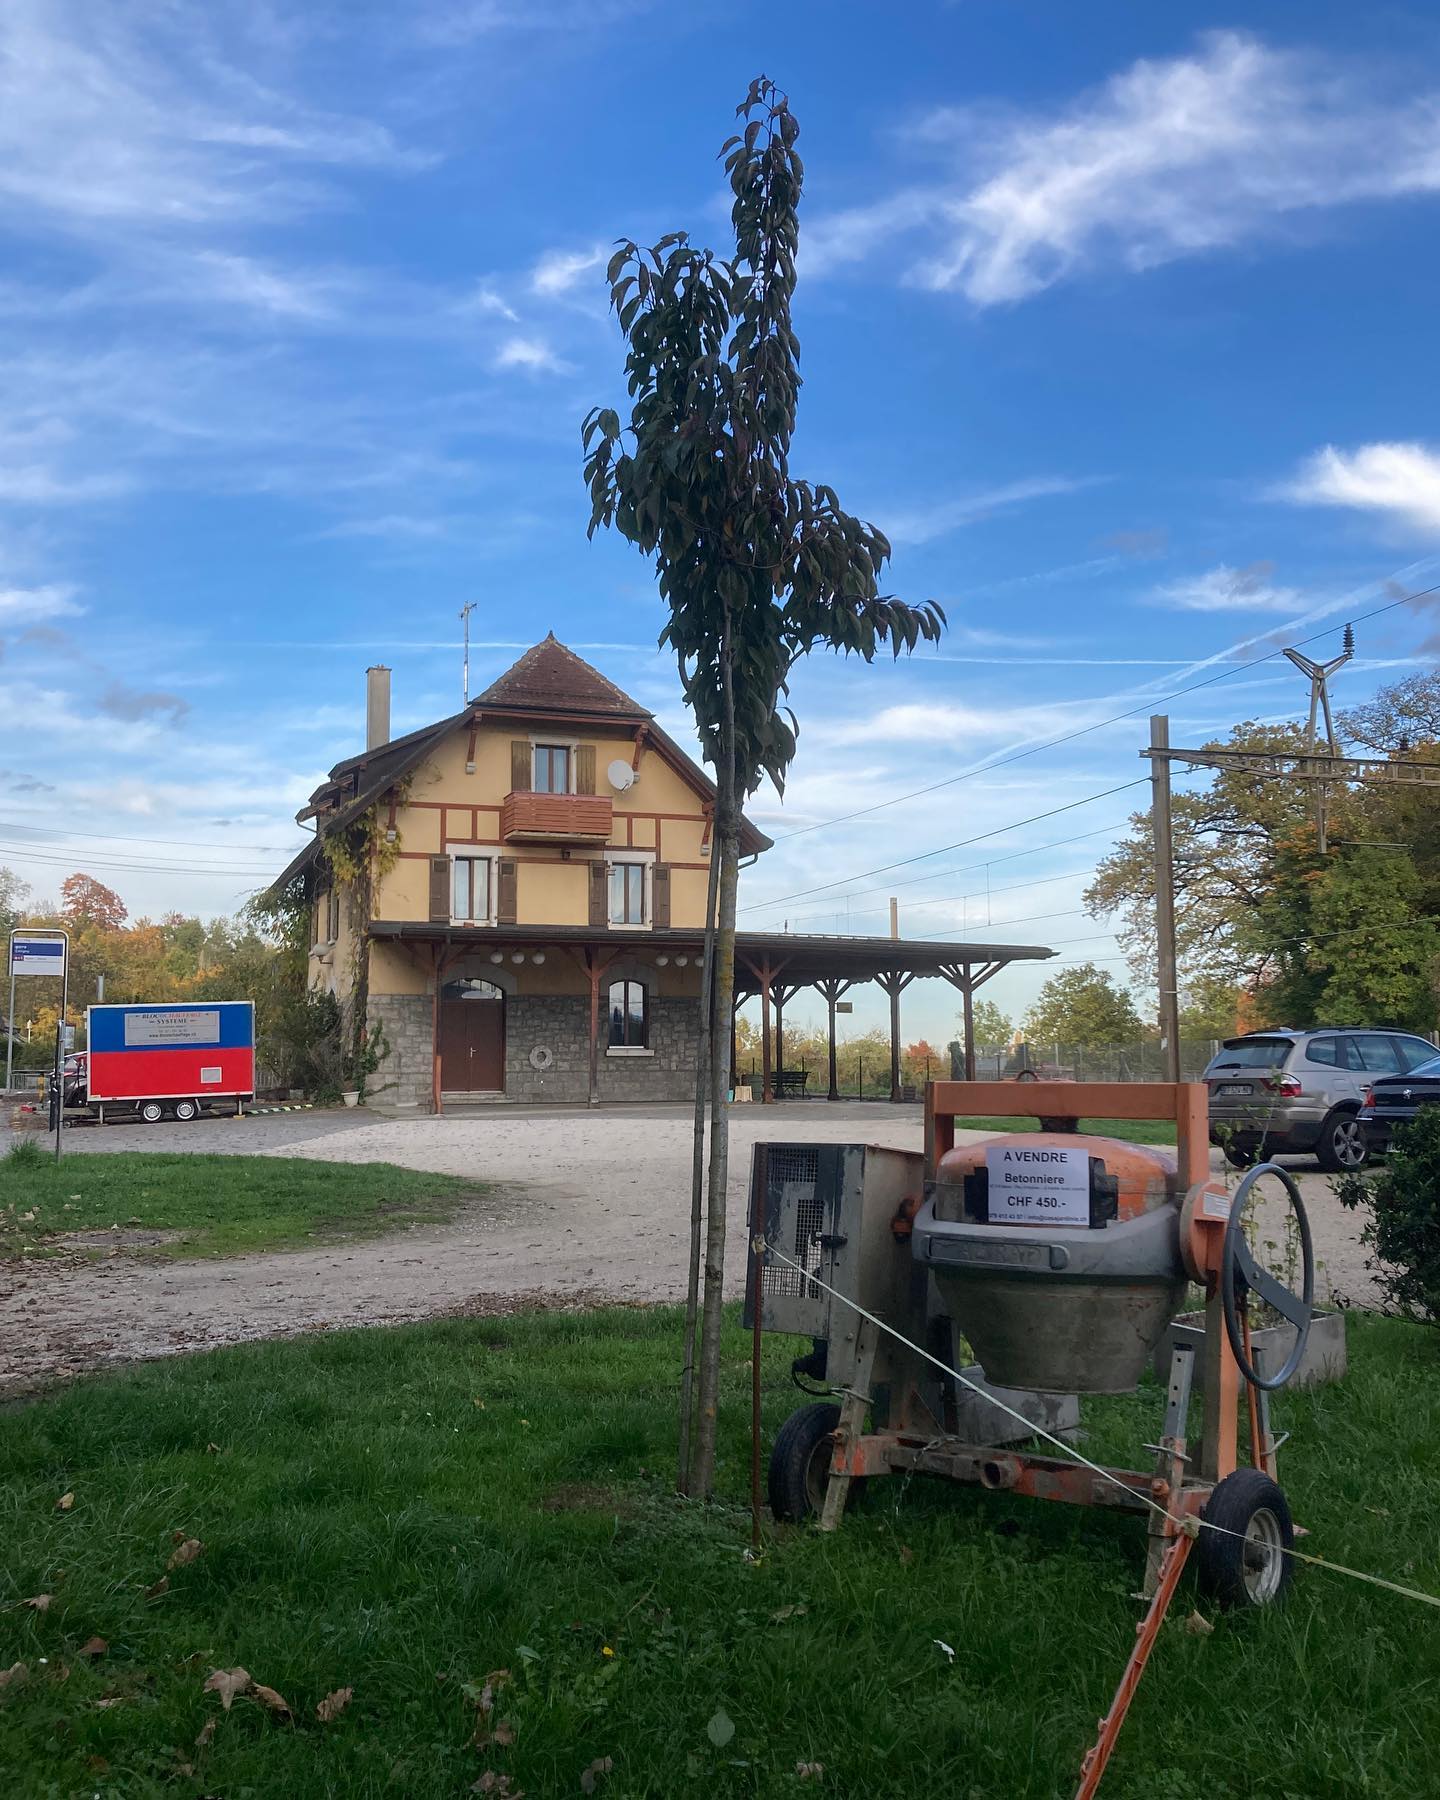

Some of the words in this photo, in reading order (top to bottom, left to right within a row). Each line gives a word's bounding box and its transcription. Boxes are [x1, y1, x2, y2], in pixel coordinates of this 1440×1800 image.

[1004, 1152, 1012, 1161] A
[1015, 1152, 1068, 1163] VENDRE
[1005, 1173, 1065, 1184] Betonniere
[1007, 1196, 1032, 1206] CHF
[1036, 1197, 1066, 1208] 450.-
